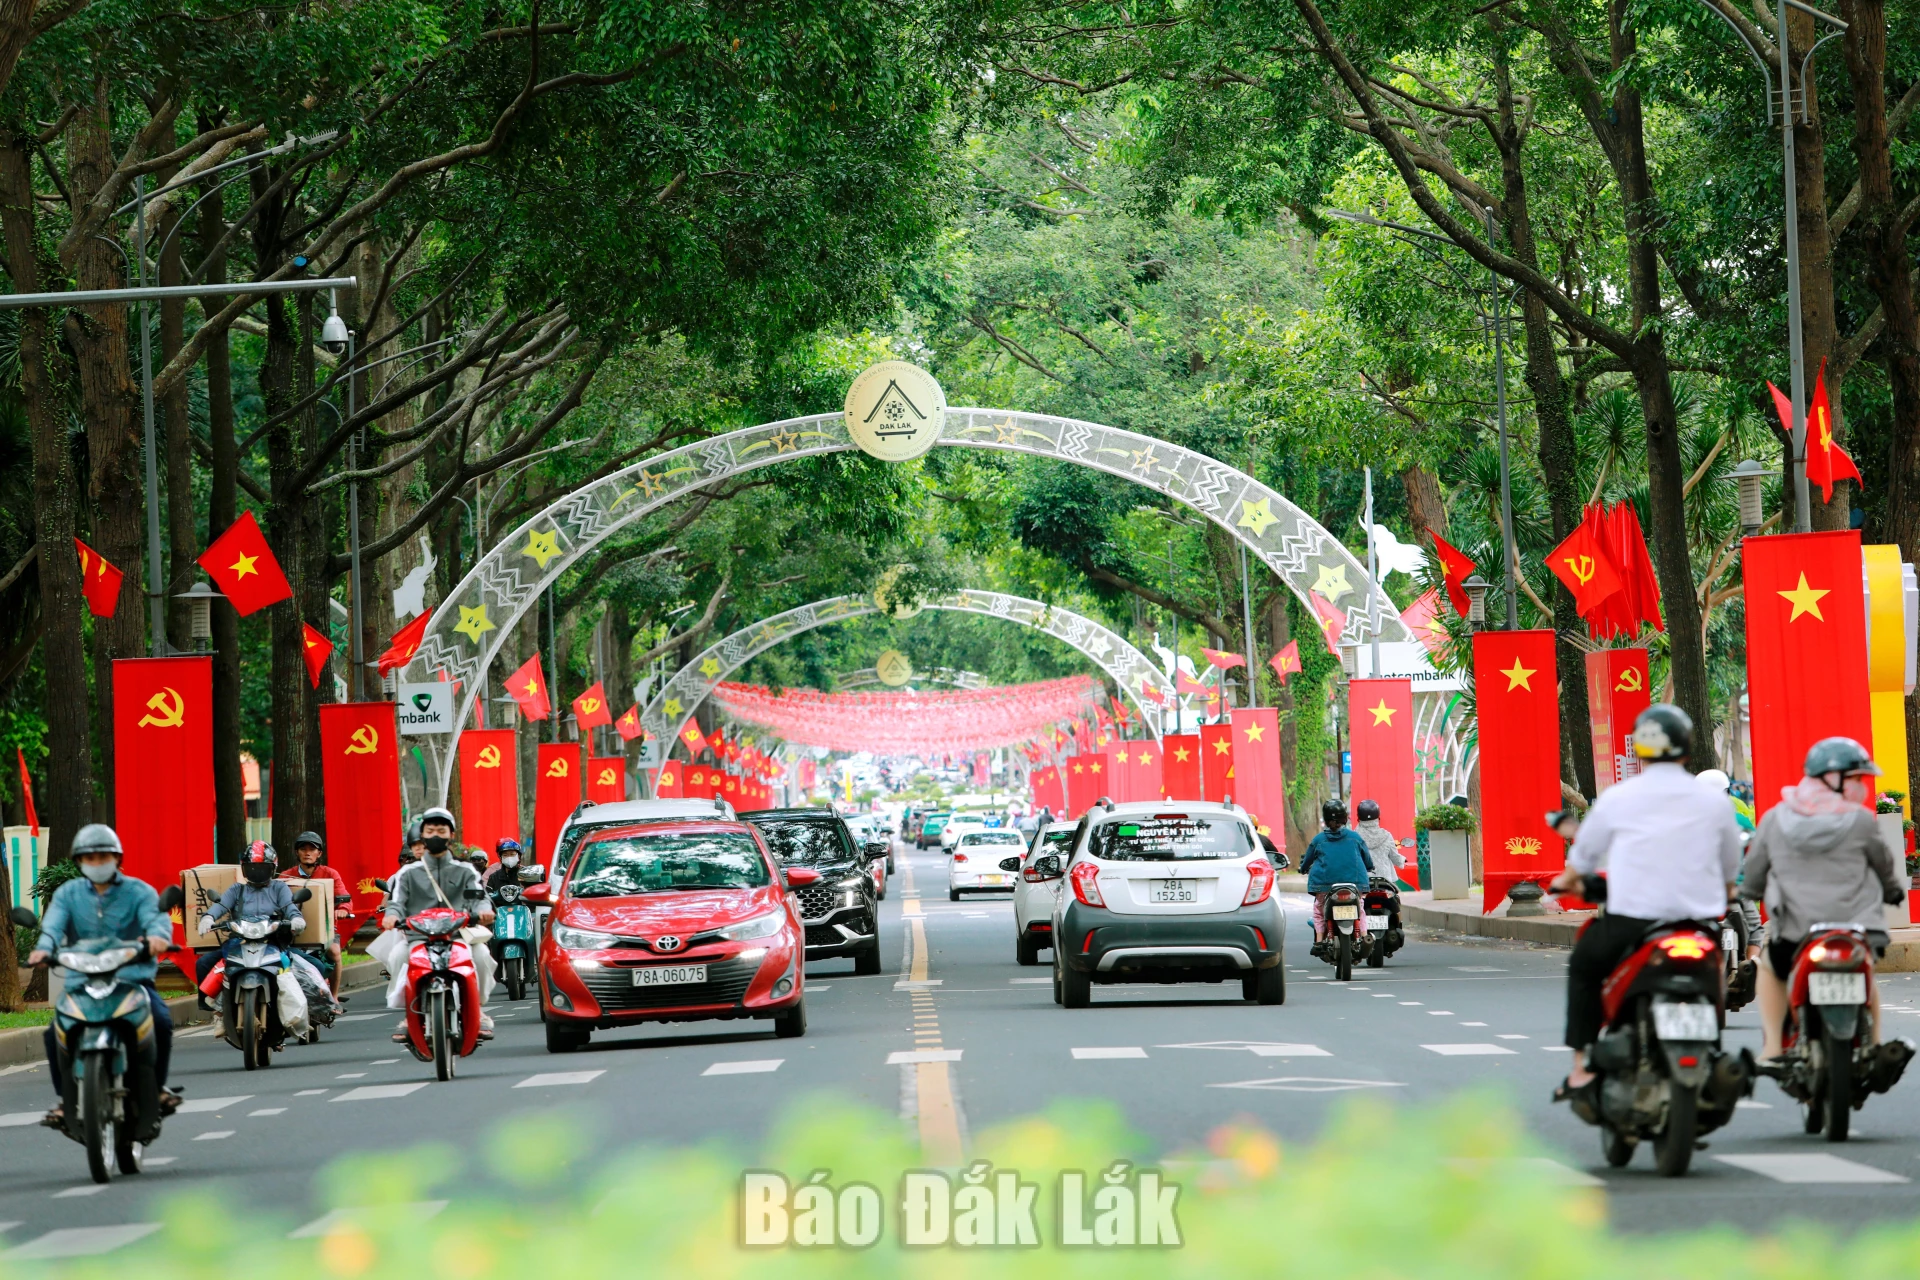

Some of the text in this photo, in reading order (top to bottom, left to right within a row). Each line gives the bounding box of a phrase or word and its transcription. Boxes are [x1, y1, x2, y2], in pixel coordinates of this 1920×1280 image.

[1163, 880, 1183, 890] 48A
[1156, 891, 1192, 901] 152.90
[635, 967, 704, 985] 78A-060.75
